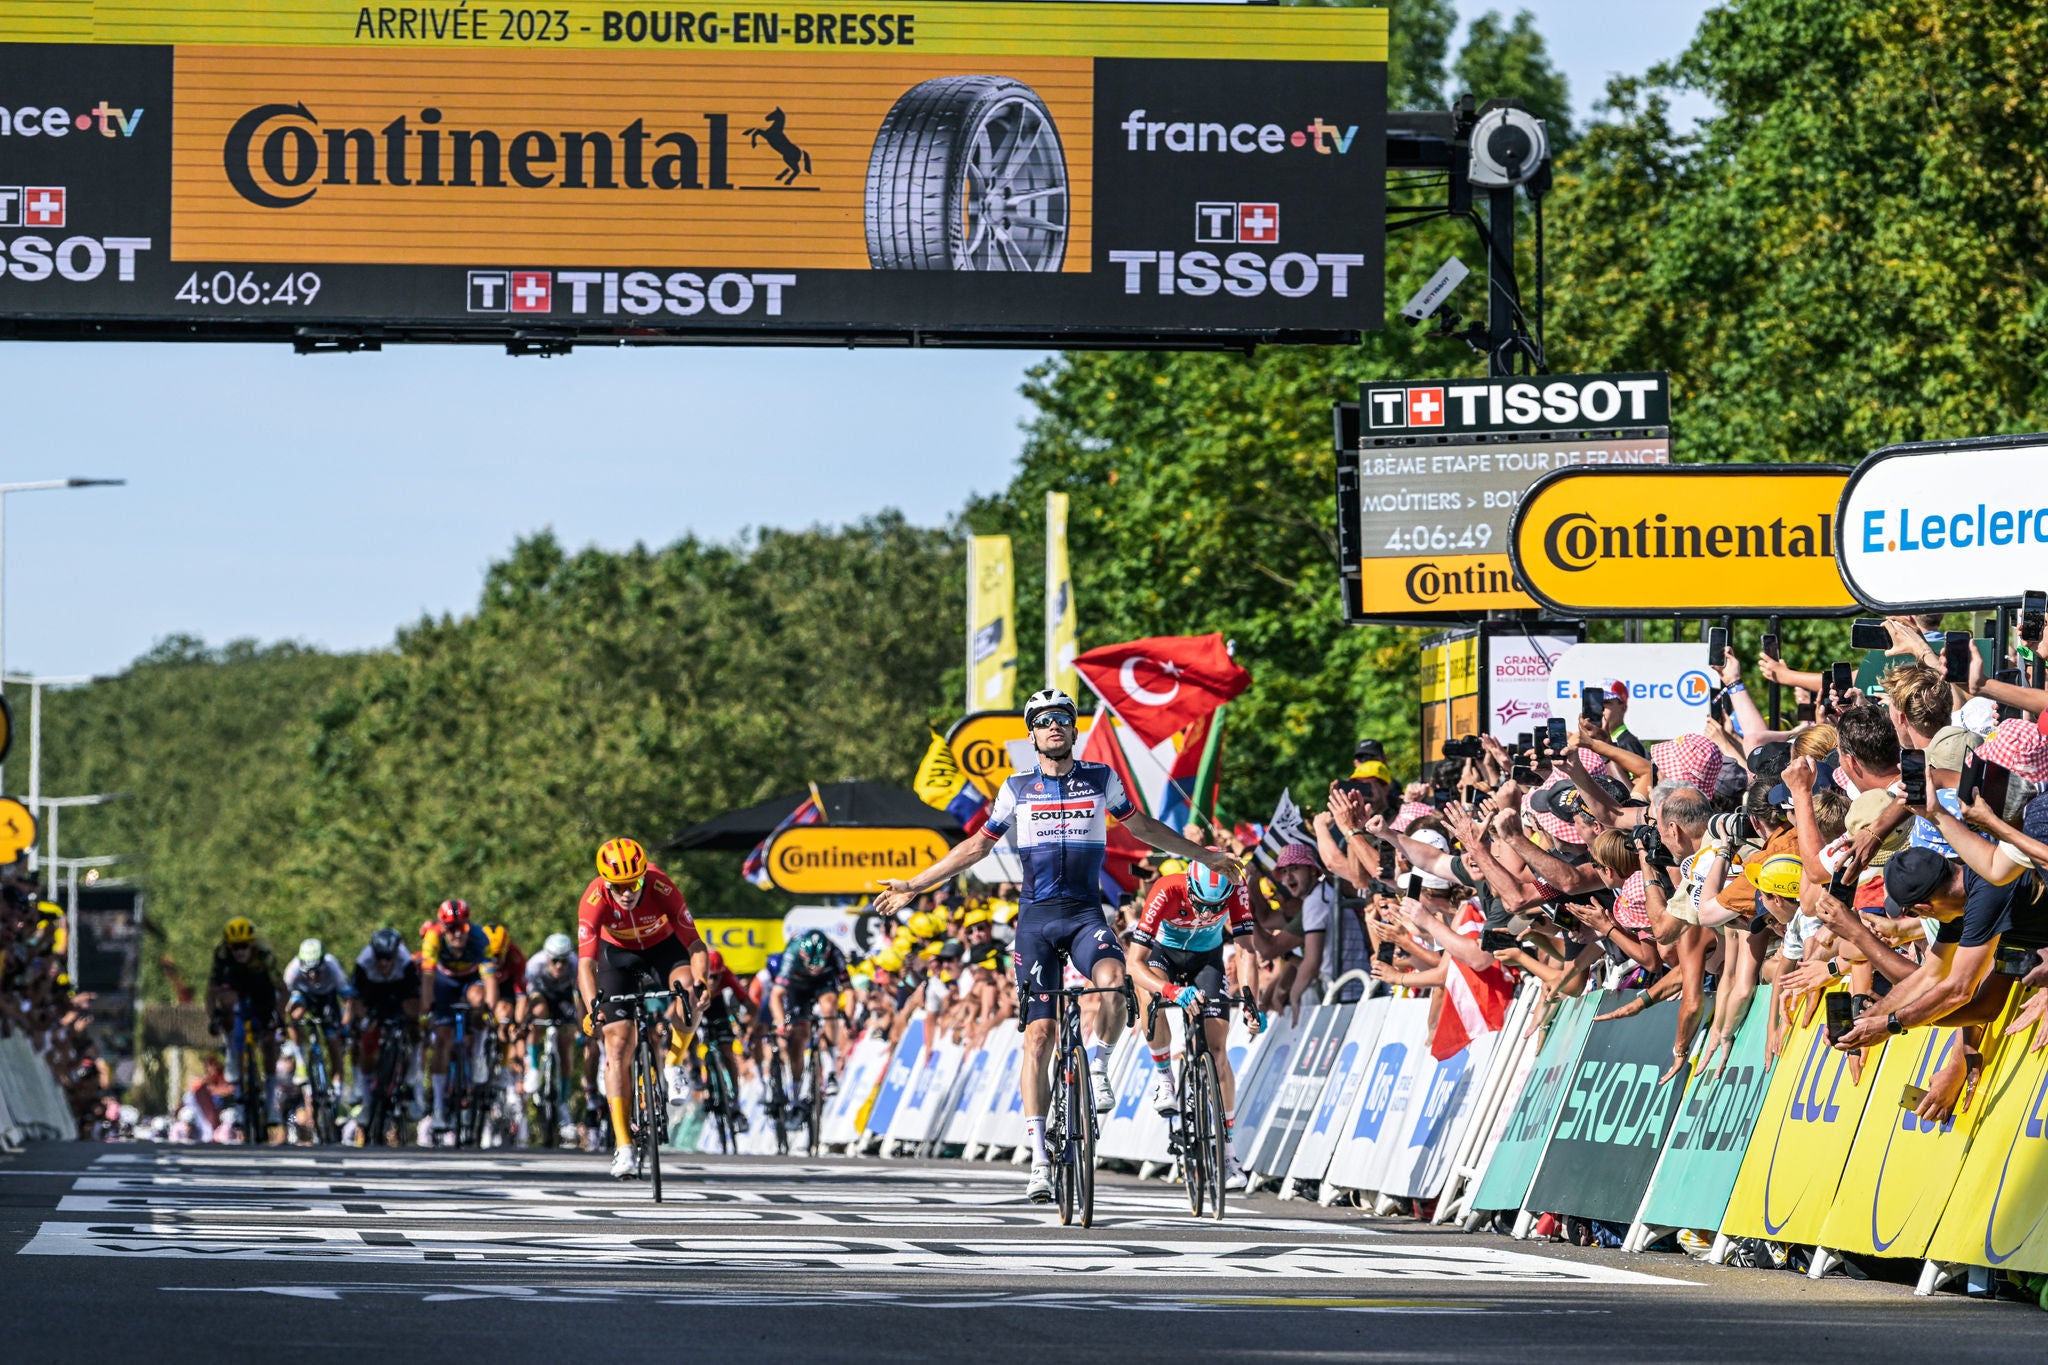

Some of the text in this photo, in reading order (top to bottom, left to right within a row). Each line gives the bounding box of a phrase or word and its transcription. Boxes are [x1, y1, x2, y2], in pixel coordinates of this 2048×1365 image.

[355, 2, 488, 40] ARRIVÉE
[499, 10, 570, 42] 2023
[602, 11, 915, 46] BOURG-EN-BRESSE
[223, 101, 734, 209] Continental
[0, 235, 152, 282] SOT
[1108, 250, 1365, 298] TISSOT
[175, 270, 322, 306] 4:06:49
[557, 271, 797, 316] TISSOT
[1448, 379, 1659, 426] TISSOT
[1362, 453, 1427, 476] 18ÈME
[1432, 454, 1492, 474] ETAPE
[1495, 451, 1550, 472] TOUR
[1555, 450, 1581, 468] DE
[1362, 487, 1461, 512] MOÛTIERS
[1384, 523, 1493, 551] 4:06:49
[1544, 511, 1836, 573] Continental
[1496, 665, 1549, 676] BOURG
[1504, 655, 1546, 665] GRAND
[1068, 788, 1096, 797] DYKA
[1031, 809, 1095, 821] SOUDAL
[779, 846, 917, 875] Continental
[1145, 888, 1168, 924] dstny
[706, 928, 765, 949] LCL
